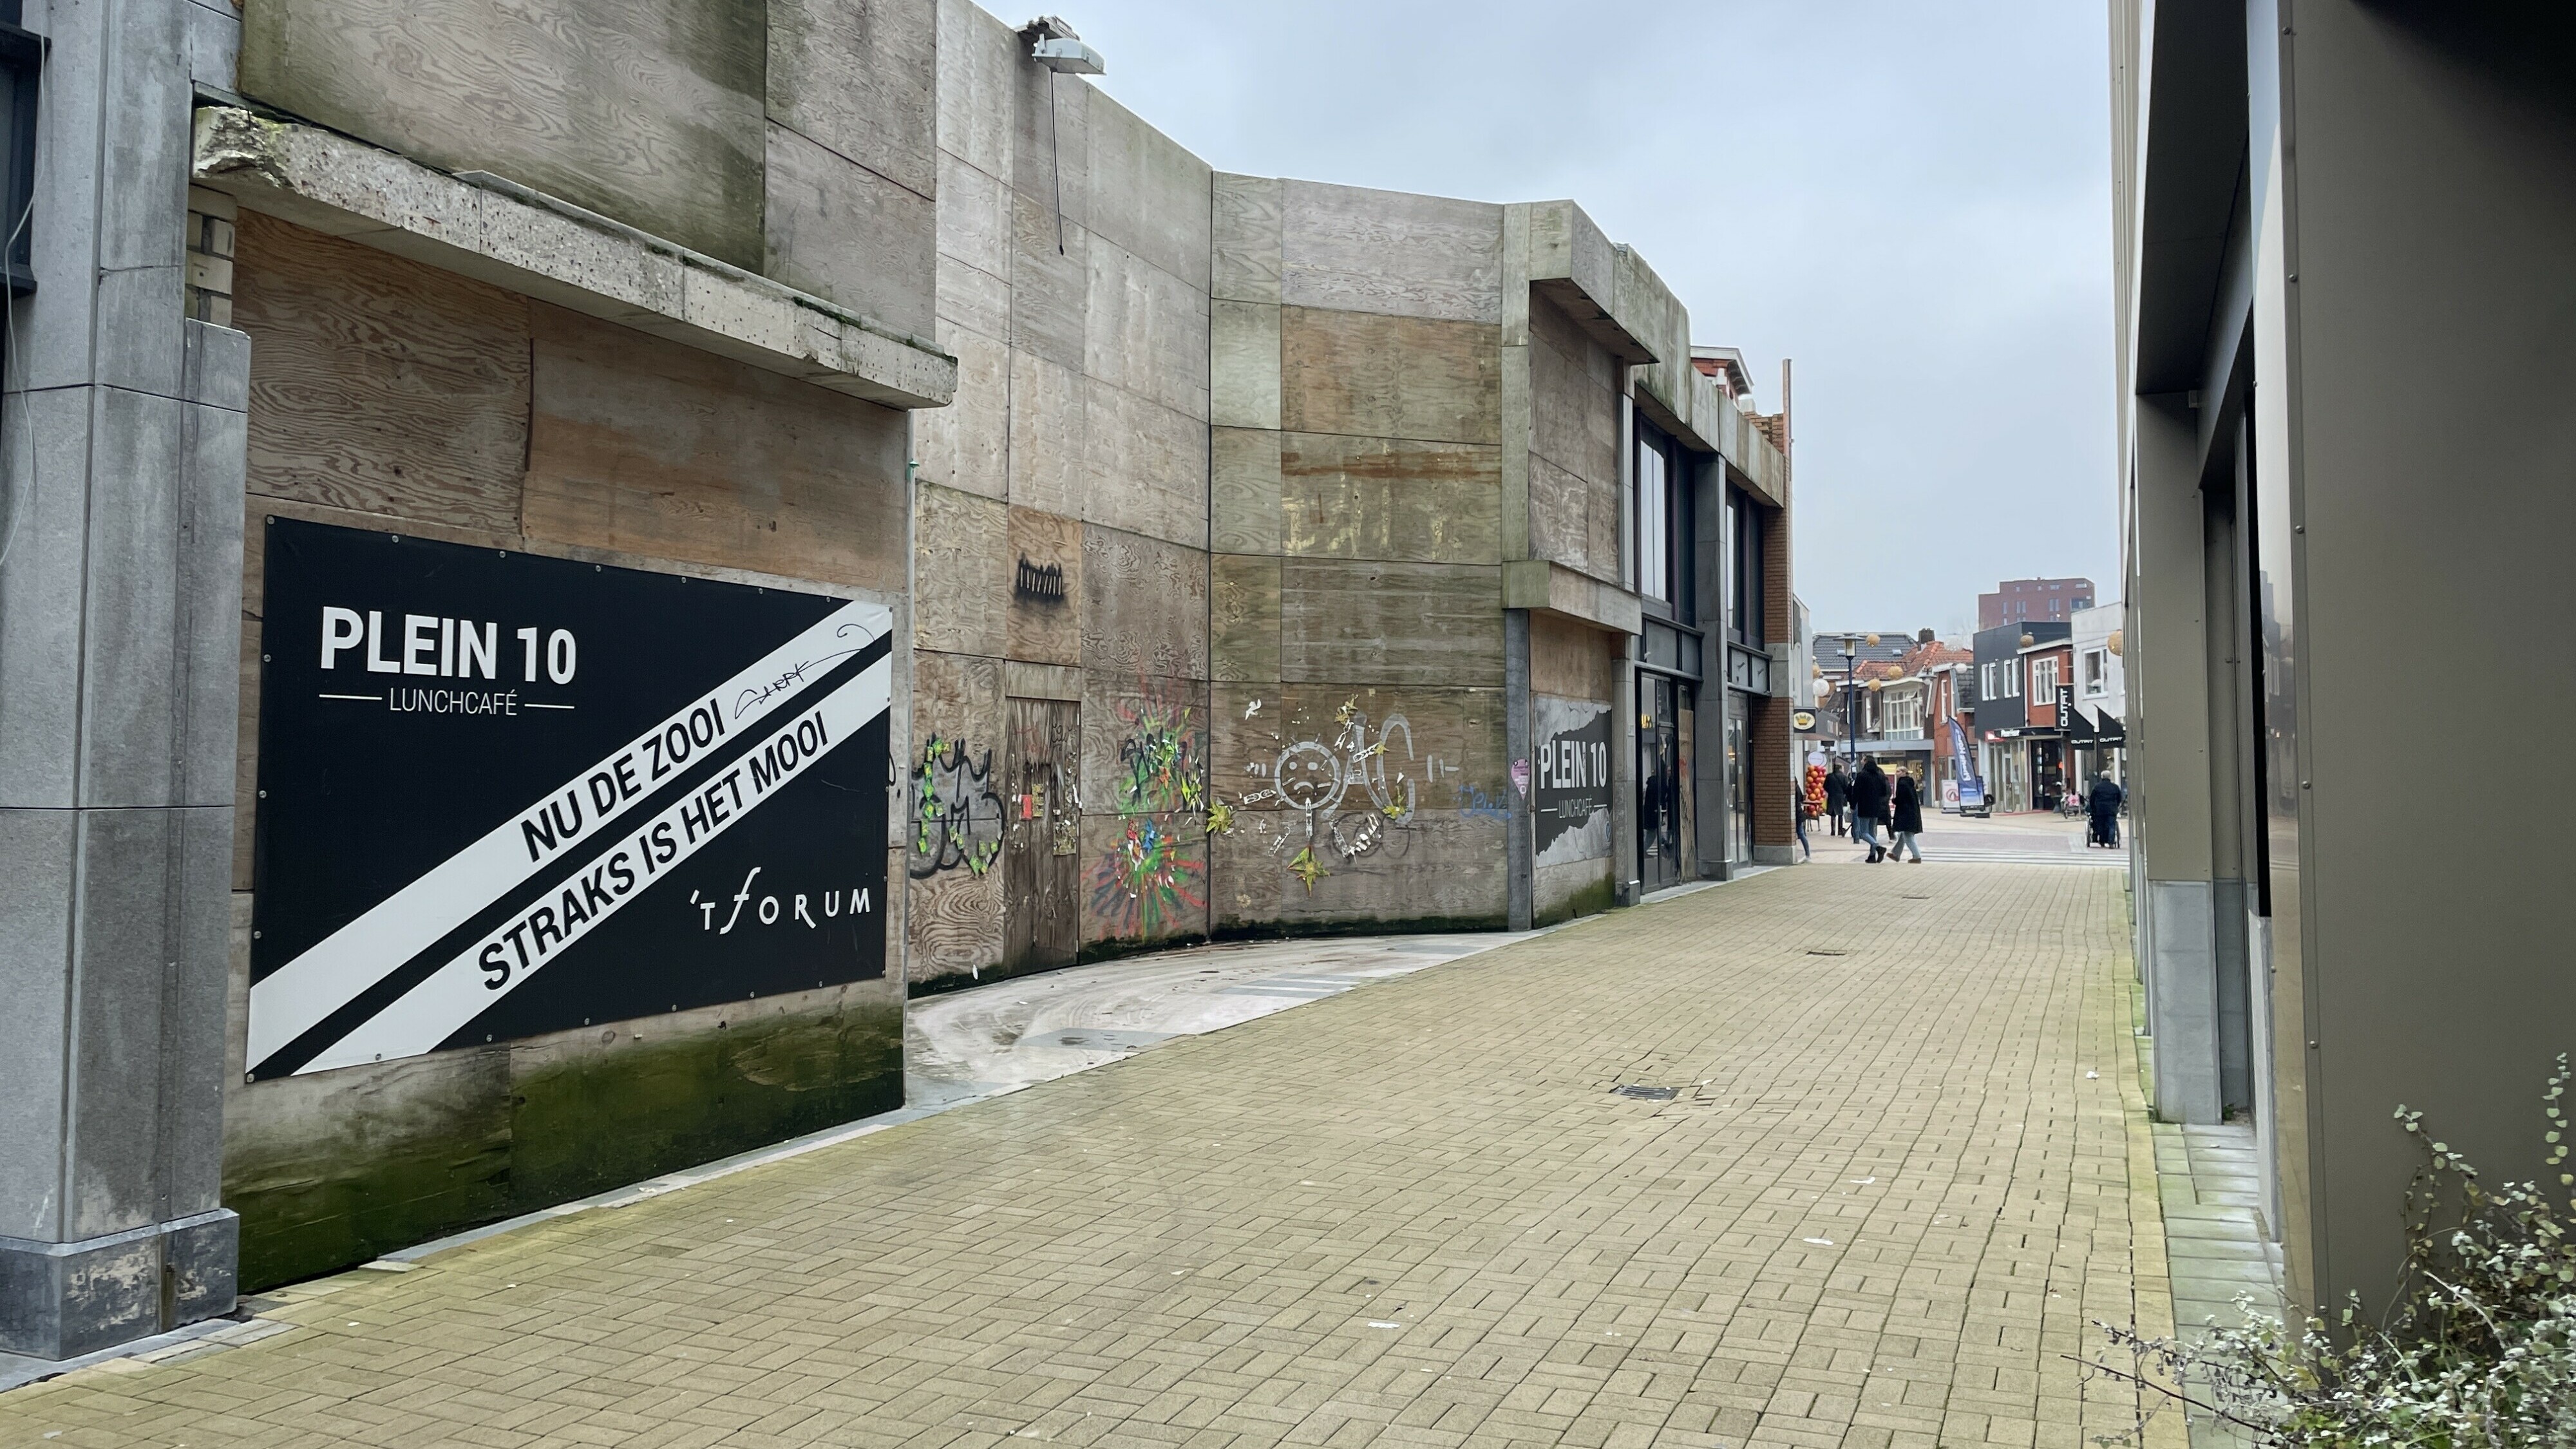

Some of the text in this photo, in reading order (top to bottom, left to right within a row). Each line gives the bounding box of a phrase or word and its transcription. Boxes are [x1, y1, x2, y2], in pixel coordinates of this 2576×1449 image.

[320, 605, 576, 685] PLEIN 10
[390, 687, 518, 715] LUNCHCAFÉ
[2060, 688, 2069, 727] OUTFIT
[520, 697, 725, 863] NU DE ZOOI
[1540, 740, 1607, 789] PLEIN 10
[478, 710, 828, 990] STRAKS IS HET MOOI
